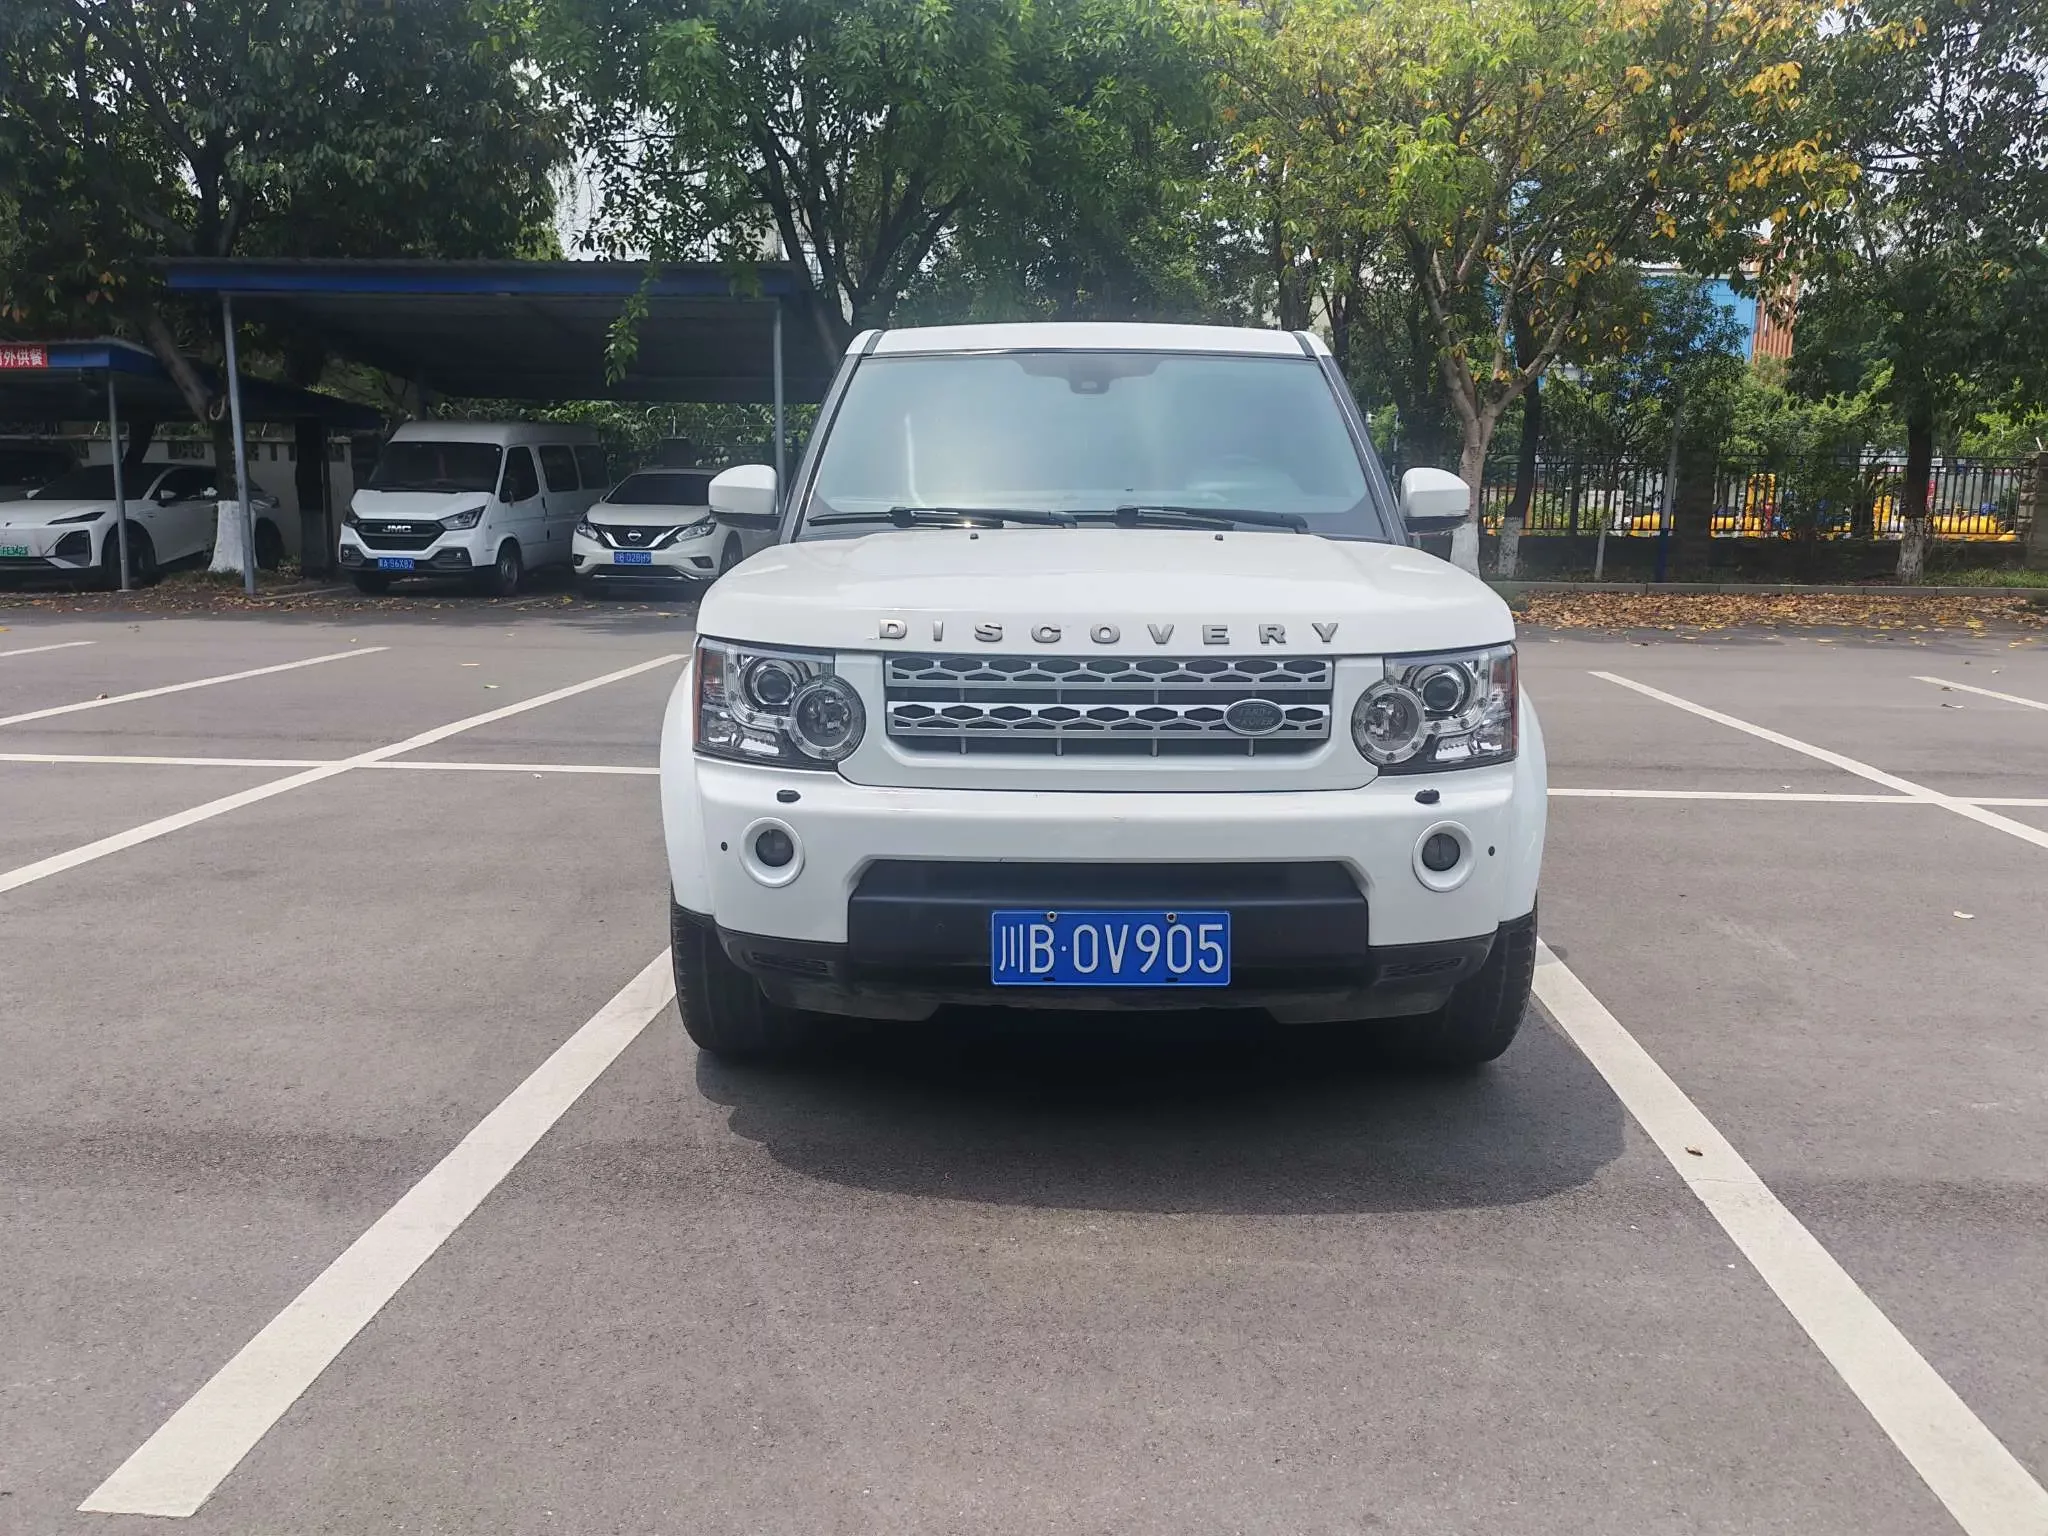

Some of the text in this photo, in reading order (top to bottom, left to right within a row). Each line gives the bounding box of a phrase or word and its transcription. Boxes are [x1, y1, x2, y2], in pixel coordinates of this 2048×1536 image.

[0, 348, 42, 366] 外供餐
[878, 618, 1338, 645] DISCOVERY
